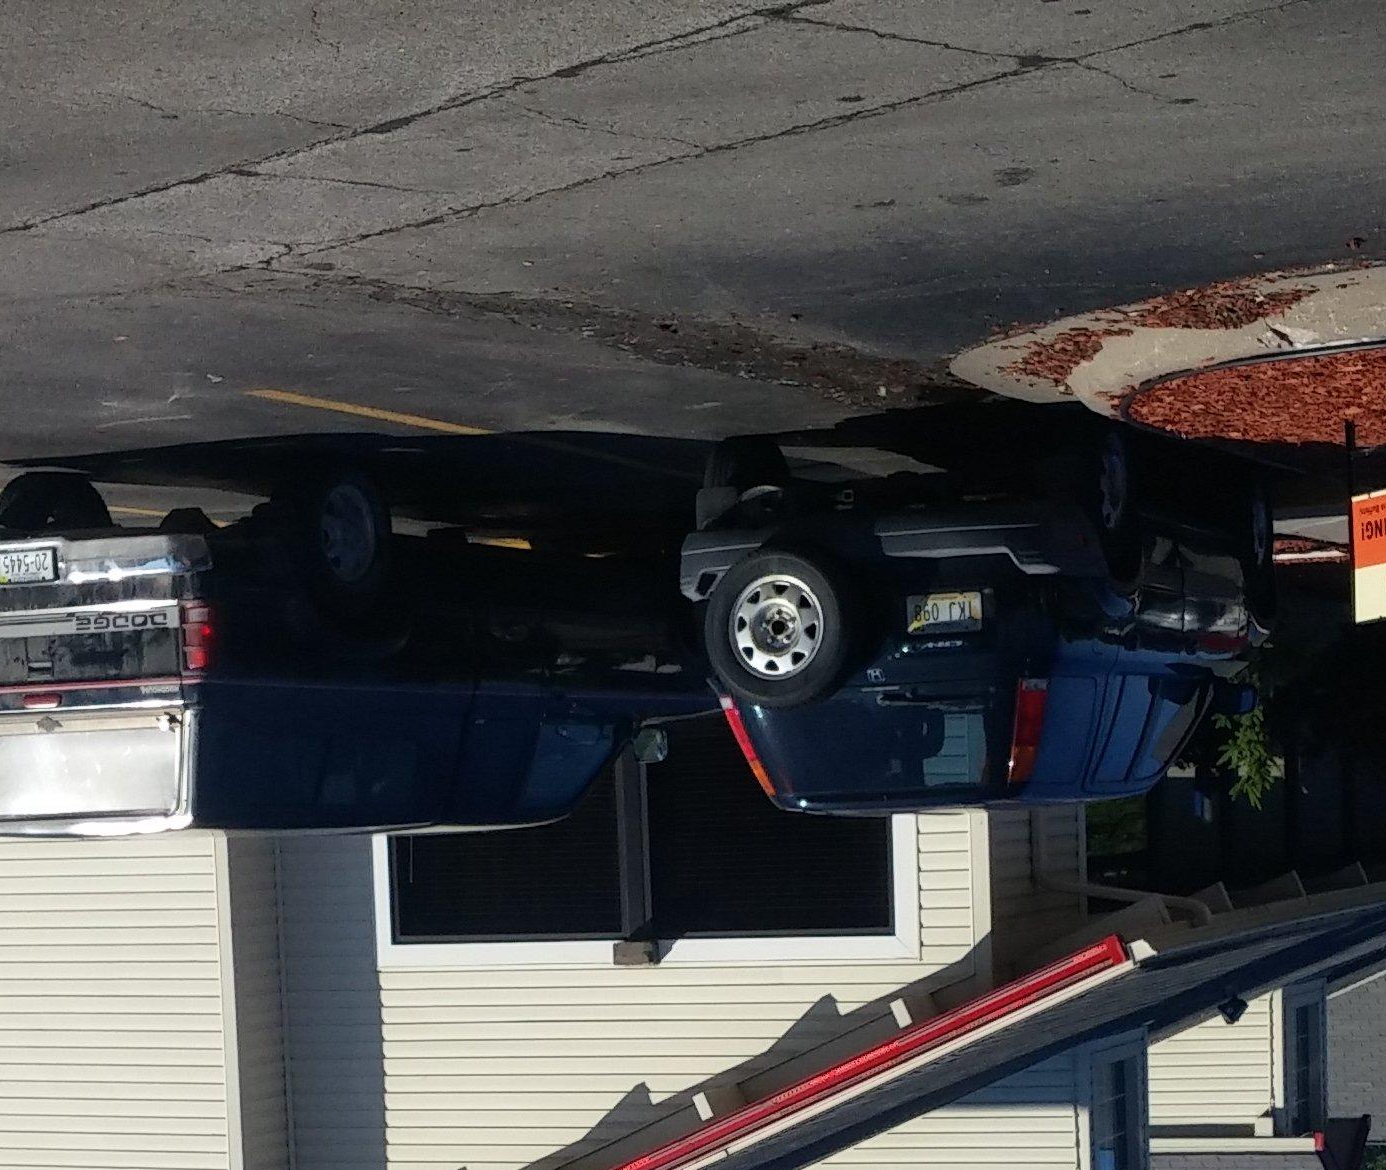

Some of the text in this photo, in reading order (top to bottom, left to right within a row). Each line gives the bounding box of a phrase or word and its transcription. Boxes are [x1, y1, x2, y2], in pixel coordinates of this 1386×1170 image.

[3, 552, 49, 574] 20-5445
[75, 612, 167, 631] DODGE
[914, 602, 939, 623] 098
